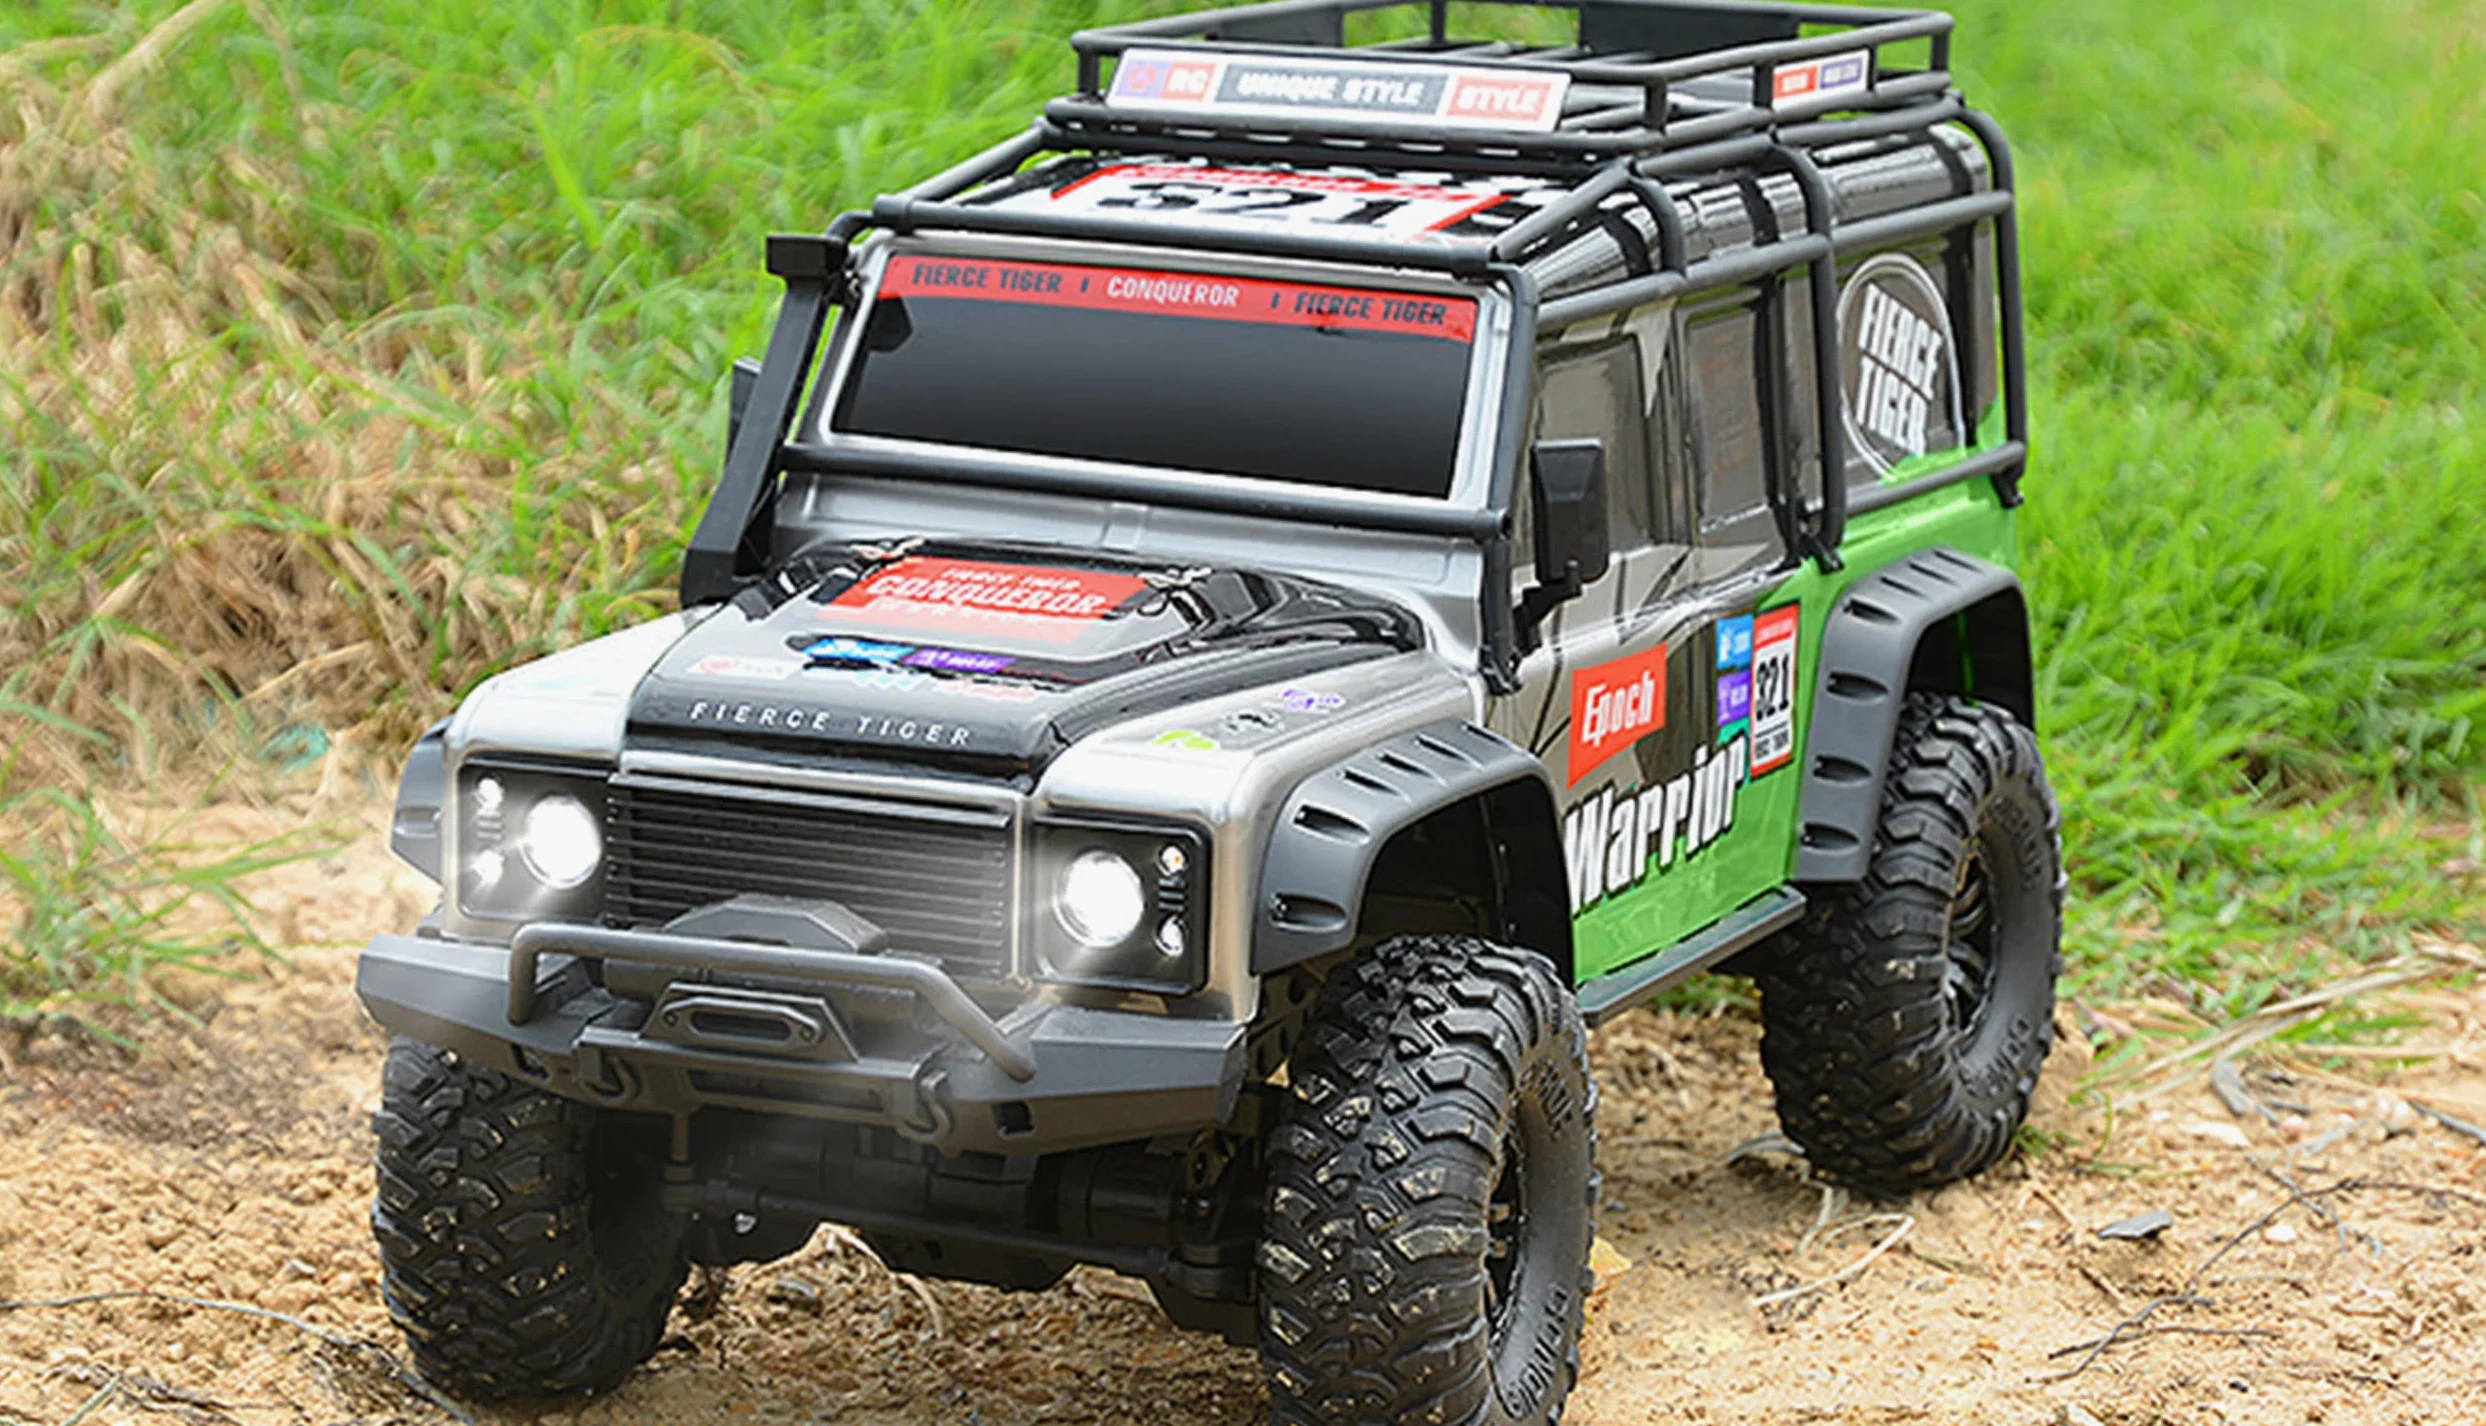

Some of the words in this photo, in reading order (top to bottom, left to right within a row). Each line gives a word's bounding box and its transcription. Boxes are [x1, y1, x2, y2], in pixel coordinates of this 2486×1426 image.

[1237, 70, 1338, 103] UNIQUE
[1343, 76, 1426, 106] STYLE
[1458, 84, 1540, 112] STYLE
[911, 264, 990, 288] FIERCE
[999, 268, 1063, 294] TIGER
[1106, 275, 1239, 306] CONQUEROR
[1293, 291, 1375, 319] FIERCE
[1382, 299, 1448, 326] TIGER
[1857, 282, 1943, 401] FIERCE
[1855, 351, 1928, 458] TIGER
[866, 575, 1108, 615] CONQUEROR
[690, 701, 831, 731] FIERCE
[856, 714, 972, 746] TIGER
[1581, 669, 1656, 748] Epoch
[1563, 735, 1747, 917] Warrior
